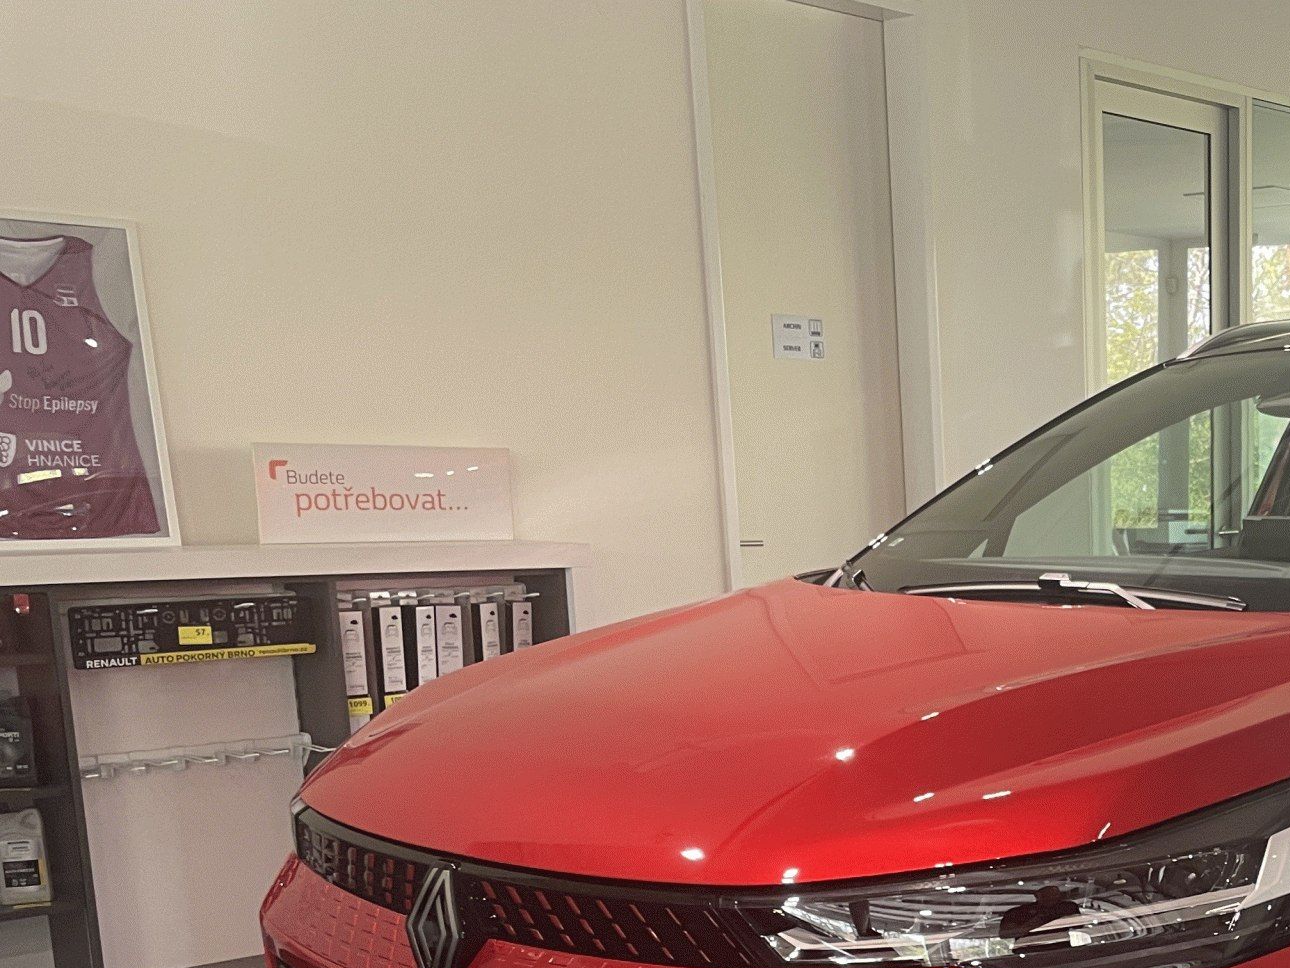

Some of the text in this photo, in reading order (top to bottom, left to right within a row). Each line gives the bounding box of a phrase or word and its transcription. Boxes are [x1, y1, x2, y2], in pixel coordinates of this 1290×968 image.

[10, 308, 48, 355] 10
[8, 393, 99, 414] Stop Epilepsy
[24, 439, 82, 452] VINICE
[27, 454, 102, 467] HNANICE
[286, 469, 345, 485] Budete
[295, 486, 468, 517] potřebovat...
[86, 656, 138, 669] RENAULT
[145, 655, 175, 665] AUTO
[176, 649, 226, 662] POKORNÝ
[227, 648, 256, 658] BRNO
